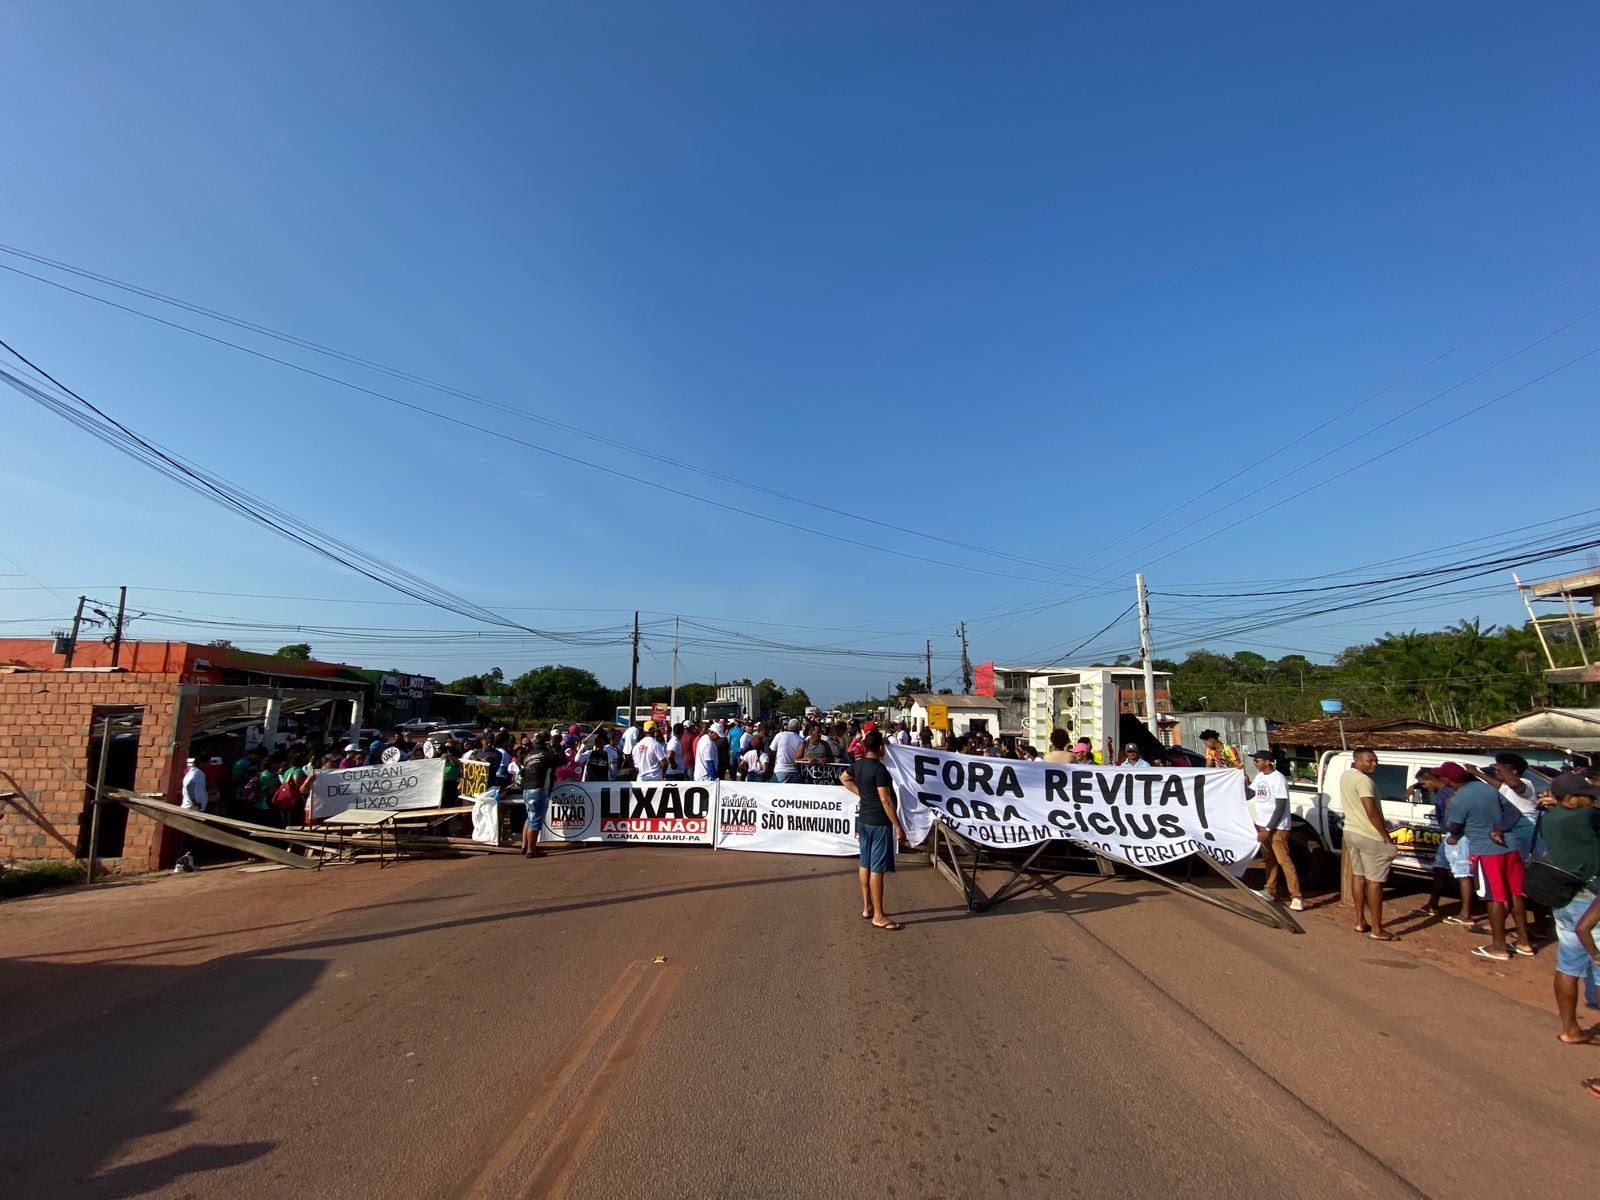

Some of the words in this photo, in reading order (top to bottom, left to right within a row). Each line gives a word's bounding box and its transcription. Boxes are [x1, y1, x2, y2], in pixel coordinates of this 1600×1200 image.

[342, 766, 403, 780] GUARANI
[462, 762, 487, 782] FORA
[914, 755, 1024, 799] FORA
[327, 784, 350, 797] DIZ
[399, 776, 418, 789] AO
[355, 793, 399, 809] LIXÃO
[601, 783, 710, 818] LIXÃO
[771, 799, 842, 811] COMUNIDADE
[551, 804, 585, 821] LIXÃO
[721, 807, 757, 825] LIXÃO
[602, 821, 652, 832] AQUI
[659, 819, 706, 832] NÃO!
[761, 810, 784, 830] SÃO
[787, 815, 850, 835] RAIMUNDO
